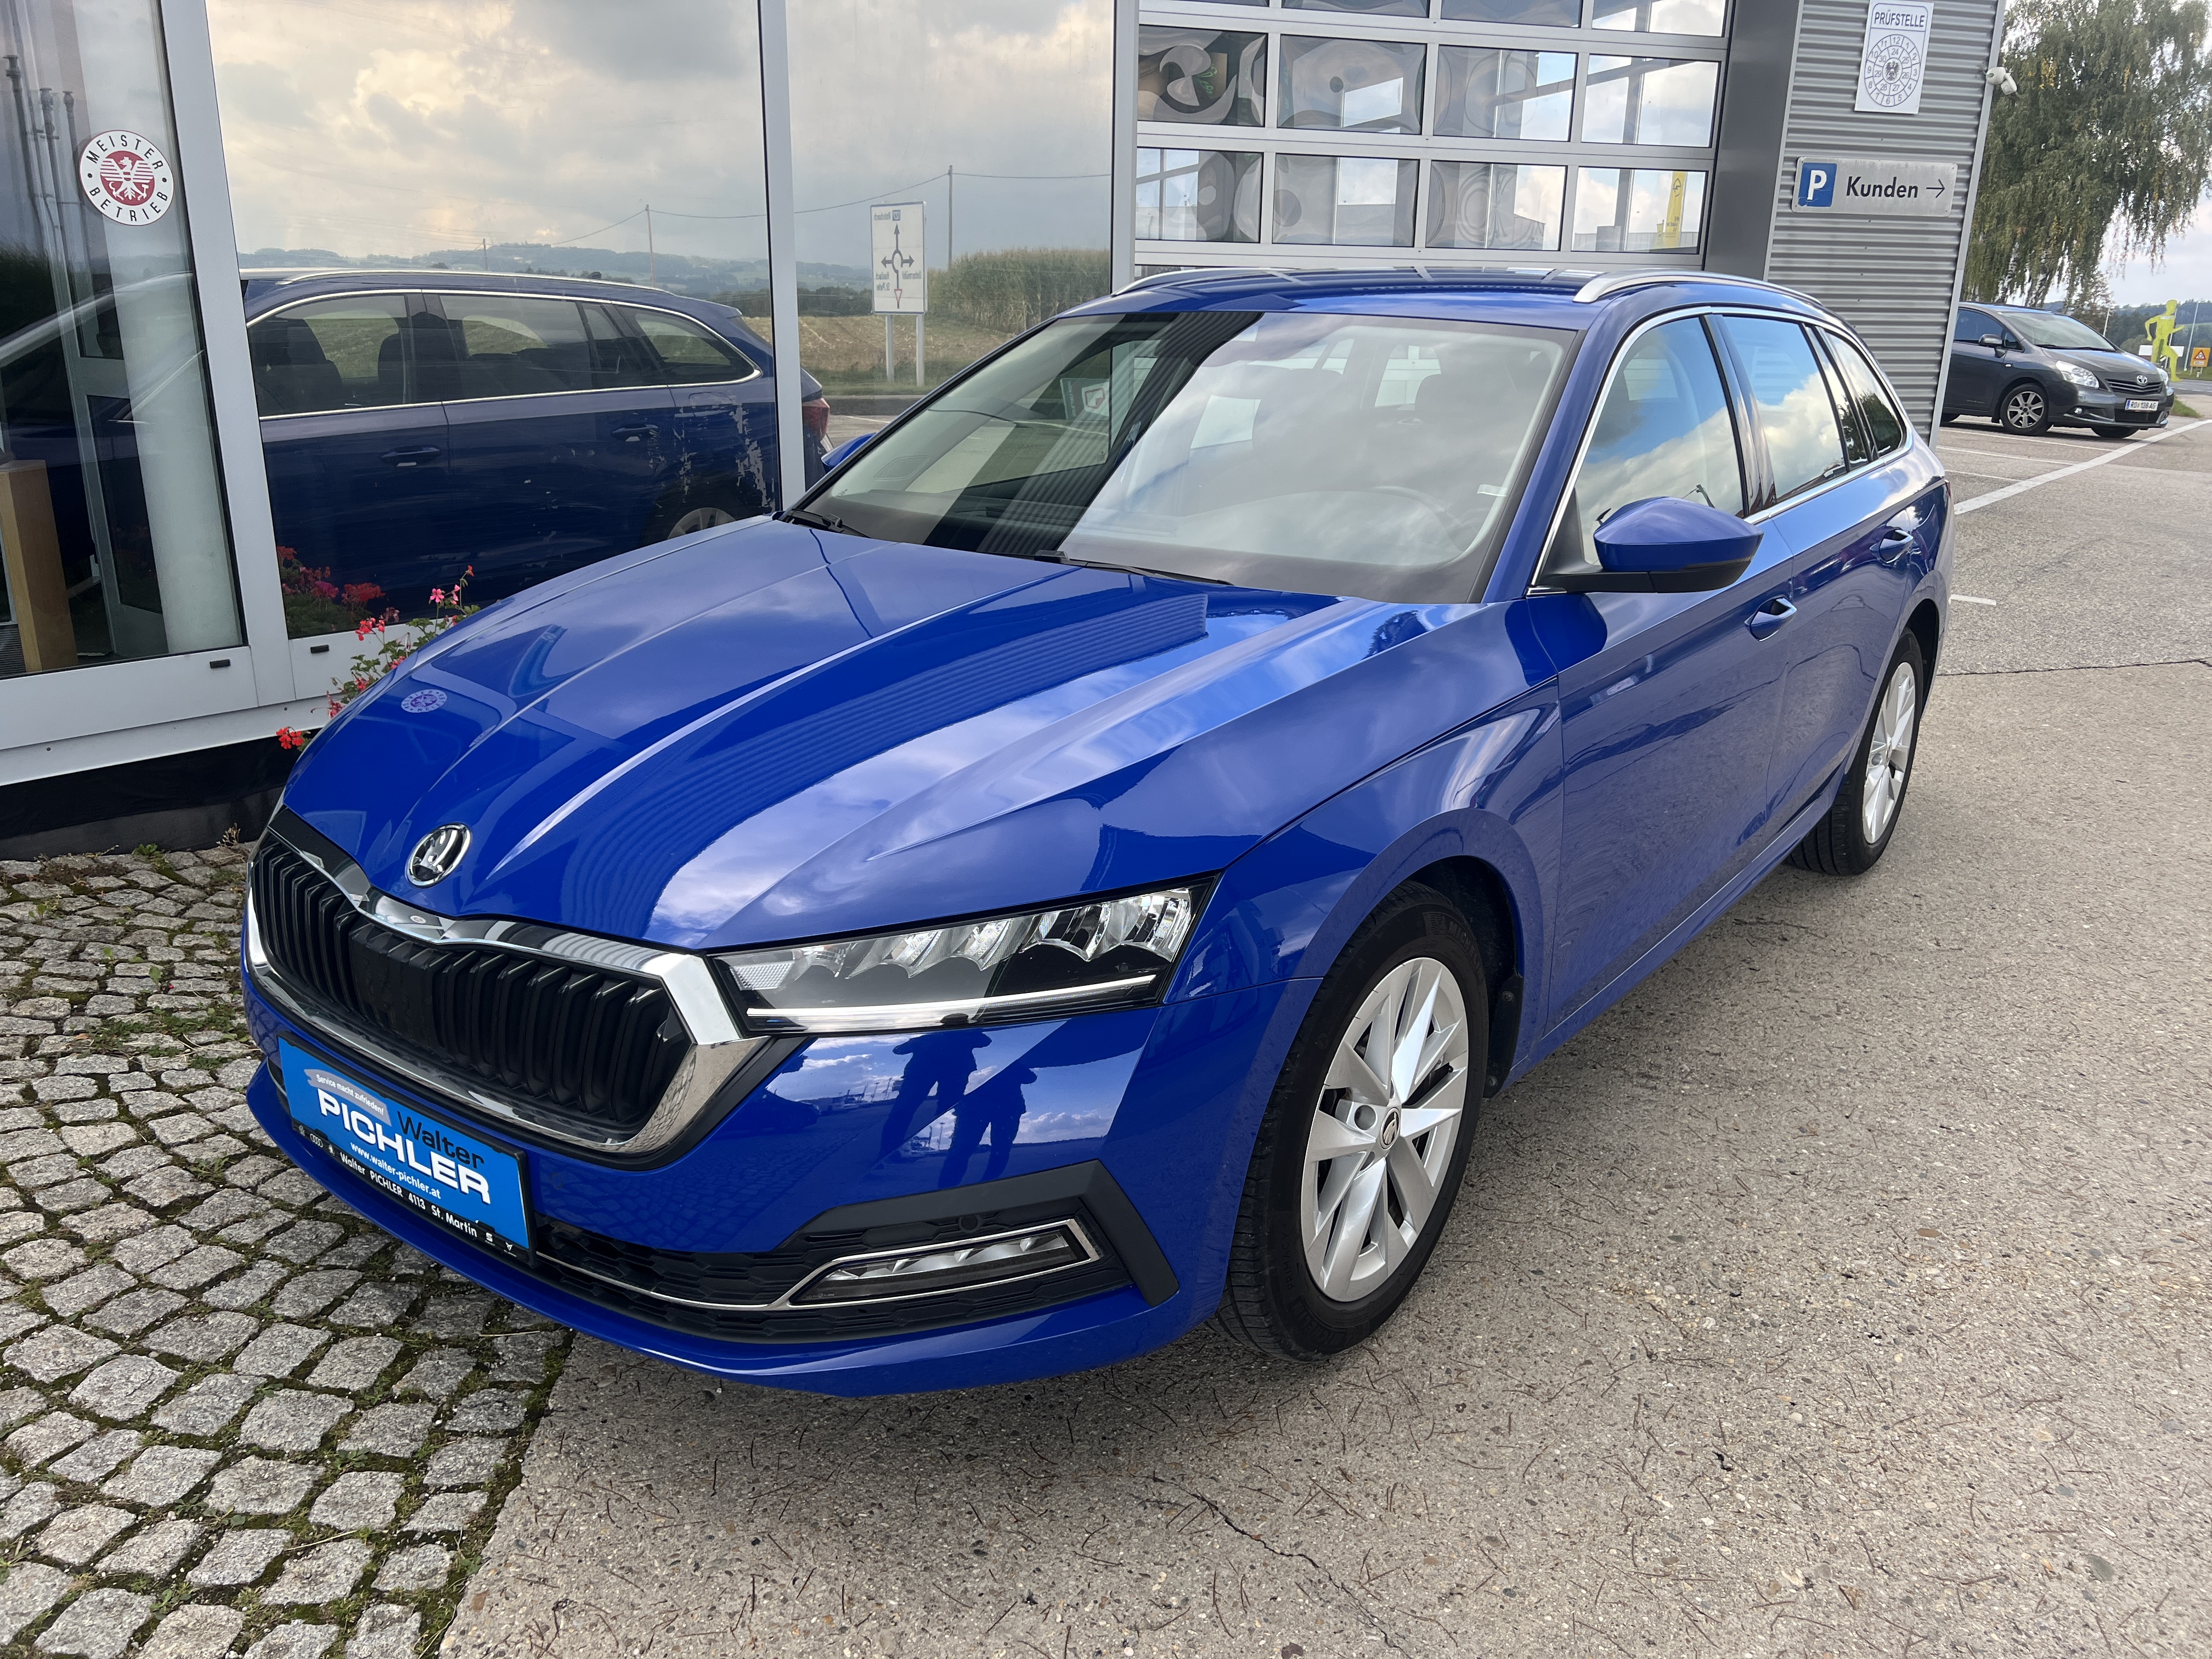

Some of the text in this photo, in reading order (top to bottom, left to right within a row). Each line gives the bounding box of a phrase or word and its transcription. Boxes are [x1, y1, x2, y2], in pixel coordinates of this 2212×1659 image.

[1874, 9, 1925, 28] PRÜFSTELLE
[1881, 40, 1887, 48] 11
[1902, 56, 1910, 64] 25
[86, 134, 163, 170] MEISTER
[1806, 170, 1918, 200] P Kunden
[89, 187, 168, 222] BETRIEB
[316, 1074, 383, 1115] Service macht zufrieden!
[318, 1088, 490, 1204] PICHLER
[397, 1110, 484, 1169] Walter
[351, 1142, 441, 1199] www.walter-pichler.at
[340, 1152, 477, 1238] Walter PICHLER 4113 St. Martin
